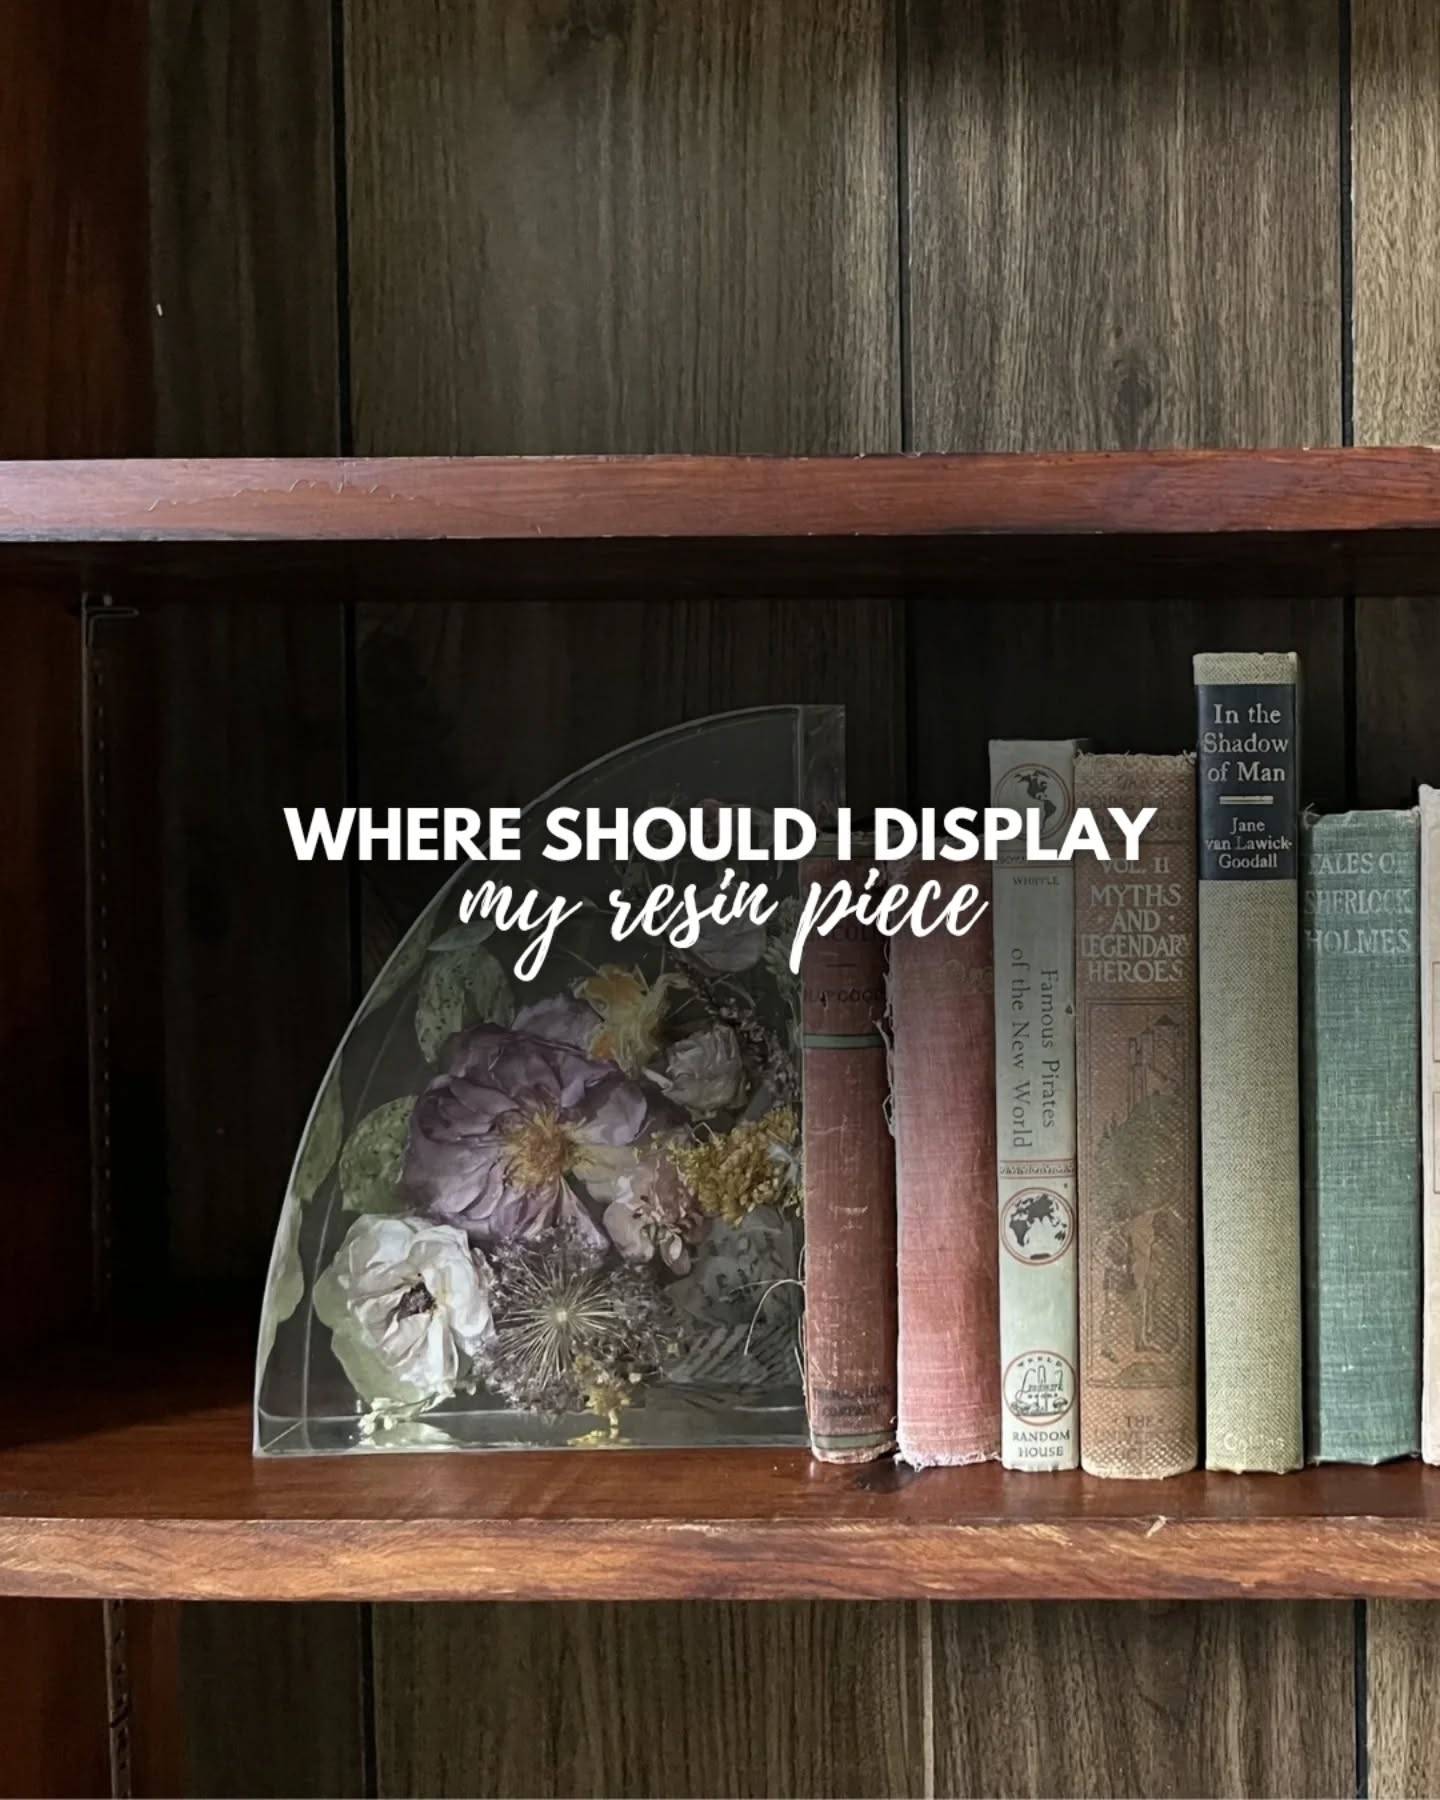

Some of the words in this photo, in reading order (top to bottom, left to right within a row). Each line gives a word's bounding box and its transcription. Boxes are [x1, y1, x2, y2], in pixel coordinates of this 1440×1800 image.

[1214, 704, 1239, 724] In
[1248, 703, 1281, 724] the
[1203, 733, 1288, 753] Shadow
[1207, 763, 1230, 782] of
[1238, 762, 1286, 782] Man
[1230, 817, 1265, 835] Jane
[1205, 839, 1232, 850] van
[1236, 835, 1293, 850] Lawick-
[1218, 854, 1278, 869] Goodall
[1089, 884, 1181, 907] MYTHS
[1304, 889, 1411, 914] SHERLOCK
[1111, 909, 1160, 932] AND
[1303, 928, 1411, 955] HOLMES
[1011, 948, 1031, 970] of
[1088, 960, 1184, 983] HEROES
[1011, 978, 1031, 1011] the
[1041, 970, 1058, 1049] Famous
[1011, 1021, 1031, 1070] New
[1041, 1059, 1061, 1128] Pirates
[1012, 1080, 1032, 1149] World
[1011, 1429, 1071, 1442] RANDOM
[1018, 1444, 1065, 1458] HOUSE
